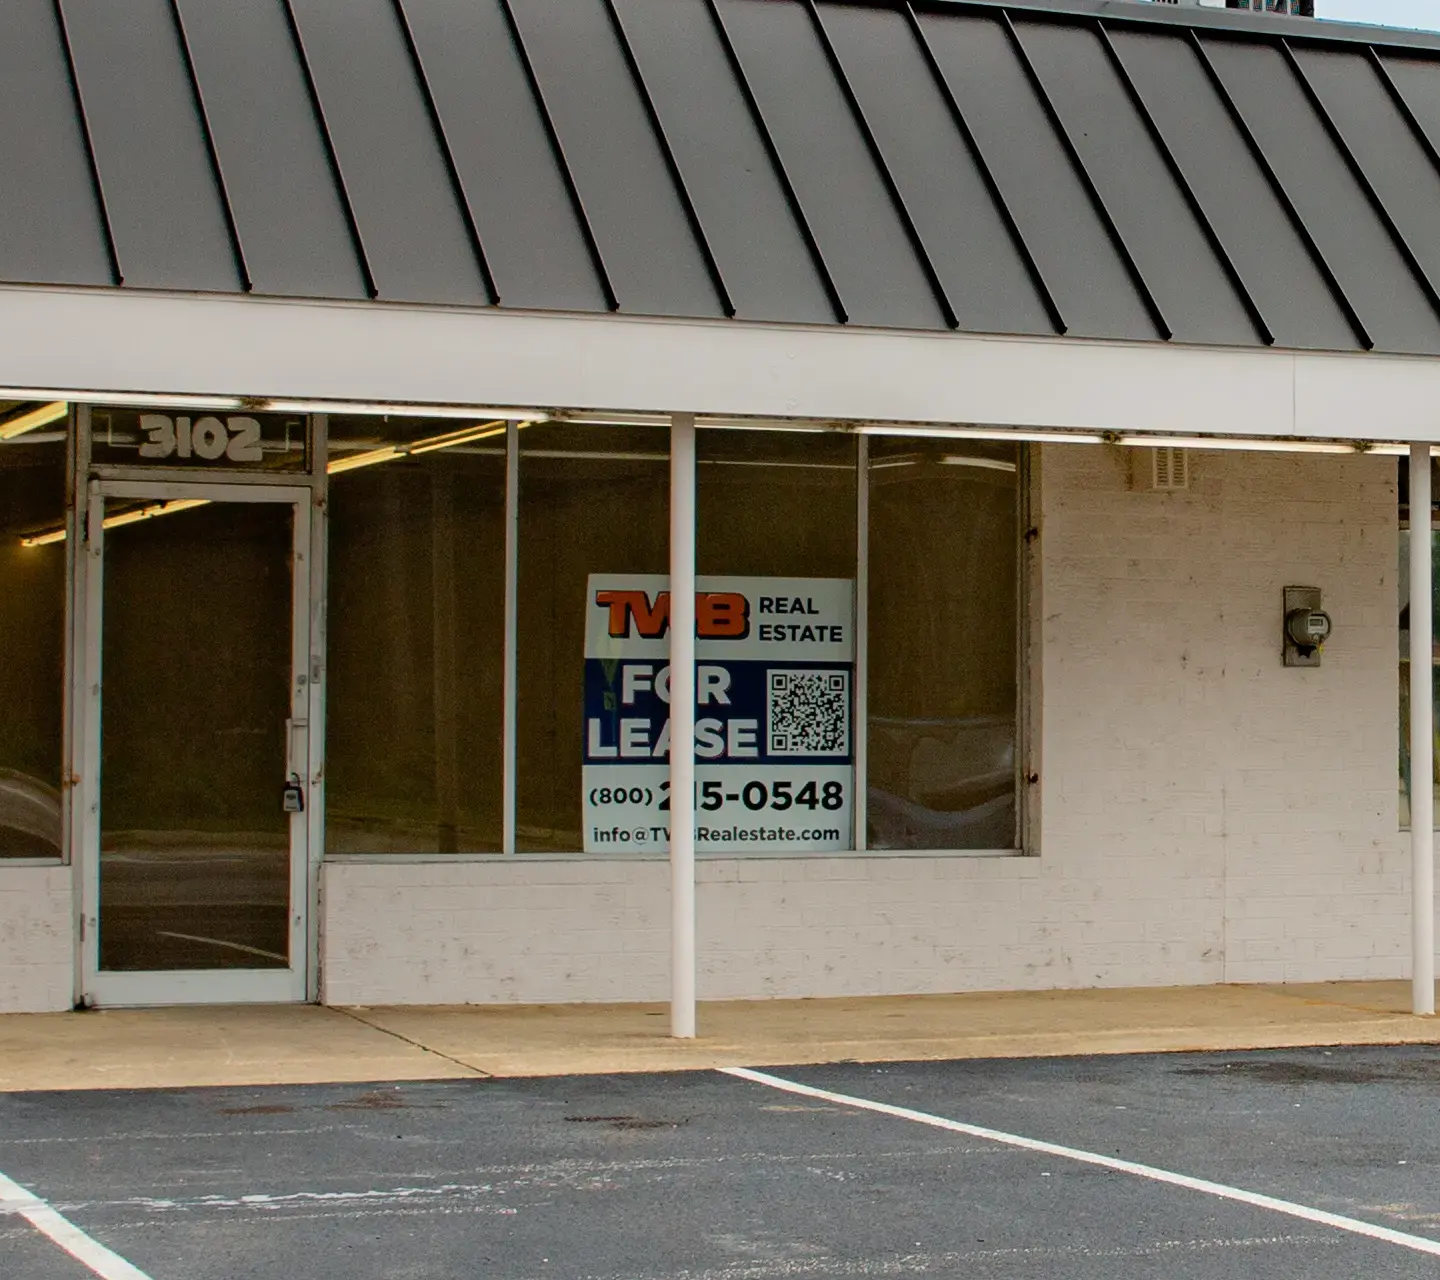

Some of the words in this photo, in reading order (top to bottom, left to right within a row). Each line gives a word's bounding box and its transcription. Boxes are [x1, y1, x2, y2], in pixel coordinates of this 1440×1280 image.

[138, 414, 264, 462] 3102
[759, 596, 820, 615] REAL
[759, 624, 843, 643] ESTATE
[589, 786, 654, 807] (800)
[593, 826, 840, 846] info@TRealestate.com
